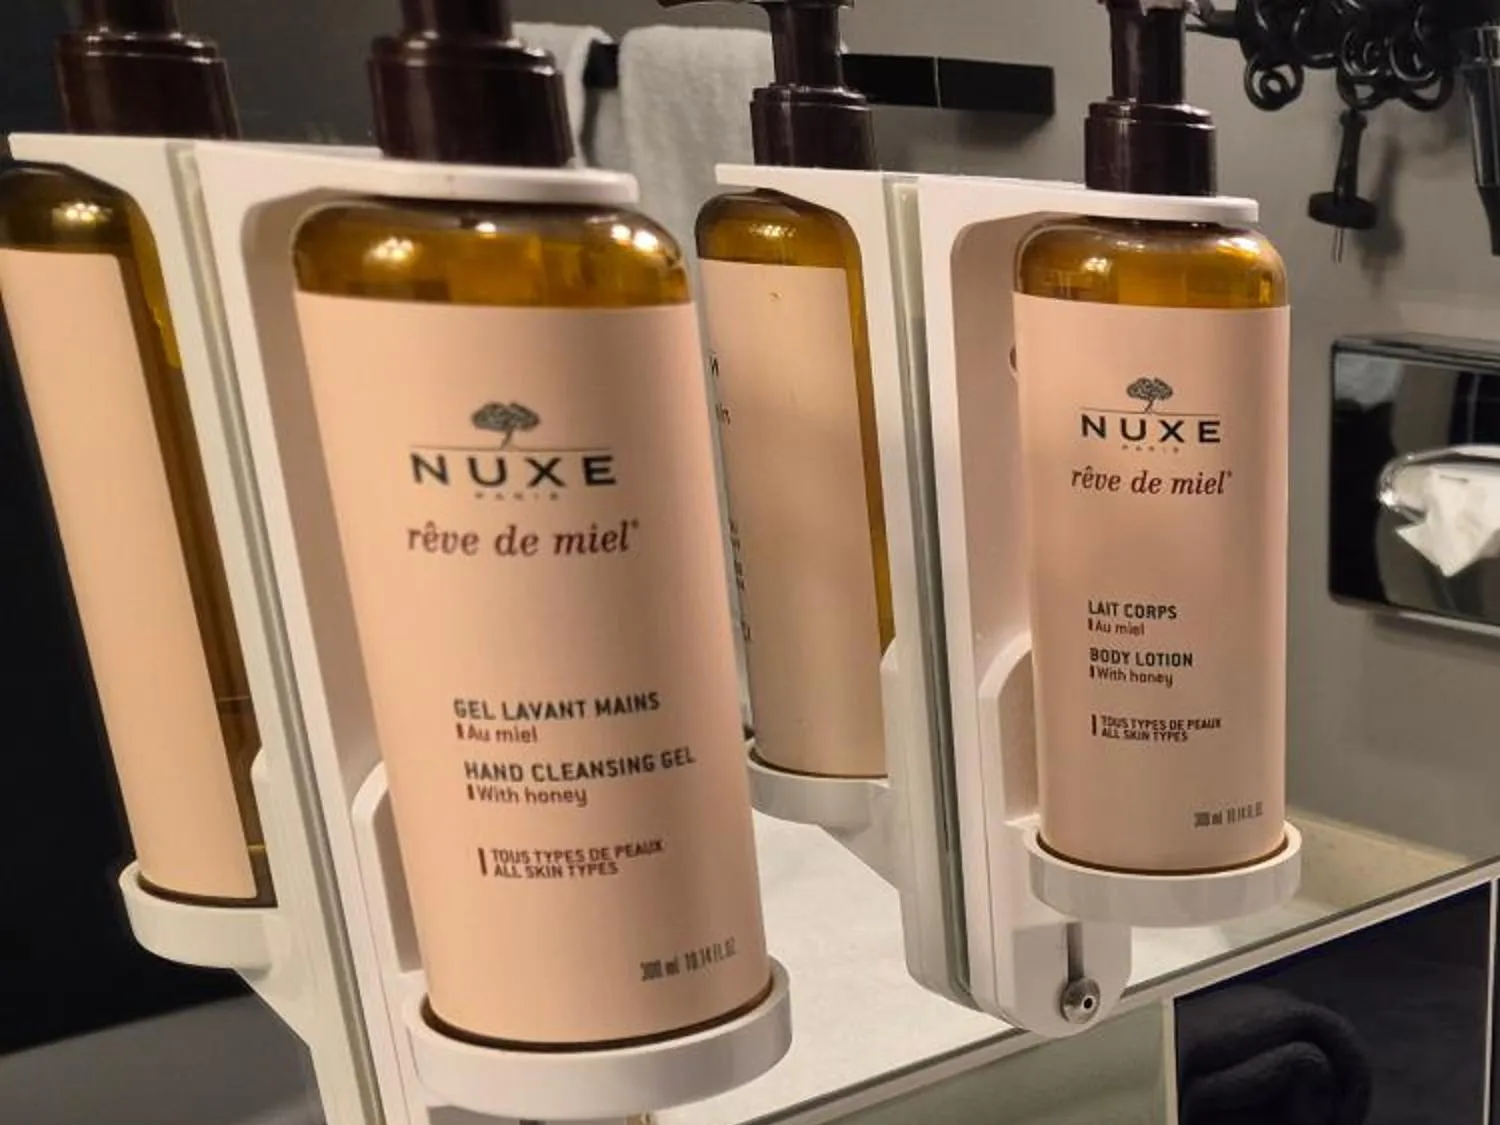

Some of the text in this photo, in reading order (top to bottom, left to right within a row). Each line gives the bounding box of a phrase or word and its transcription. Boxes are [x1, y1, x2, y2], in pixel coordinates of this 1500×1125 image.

[1081, 414, 1221, 444] NUXE
[410, 454, 617, 487] NUXE
[1071, 465, 1121, 491] rêve
[1131, 469, 1161, 494] de
[407, 520, 479, 556] rêve
[494, 524, 540, 556] de
[1088, 599, 1177, 620] LAIT CORPS
[1095, 619, 1145, 636] Au miel
[1089, 647, 1193, 668] BODY LOTION
[1097, 665, 1173, 689] With honey
[453, 692, 661, 720] GEL LAVANT MAINS
[467, 725, 538, 743] Au miel
[1169, 718, 1184, 730] DE
[463, 746, 696, 782] HAND CLEANSING GEL
[476, 784, 588, 808] With honey
[490, 840, 665, 864] TOUS TYPES DE PEAUX
[493, 861, 618, 878] ALL SKIN TYPES
